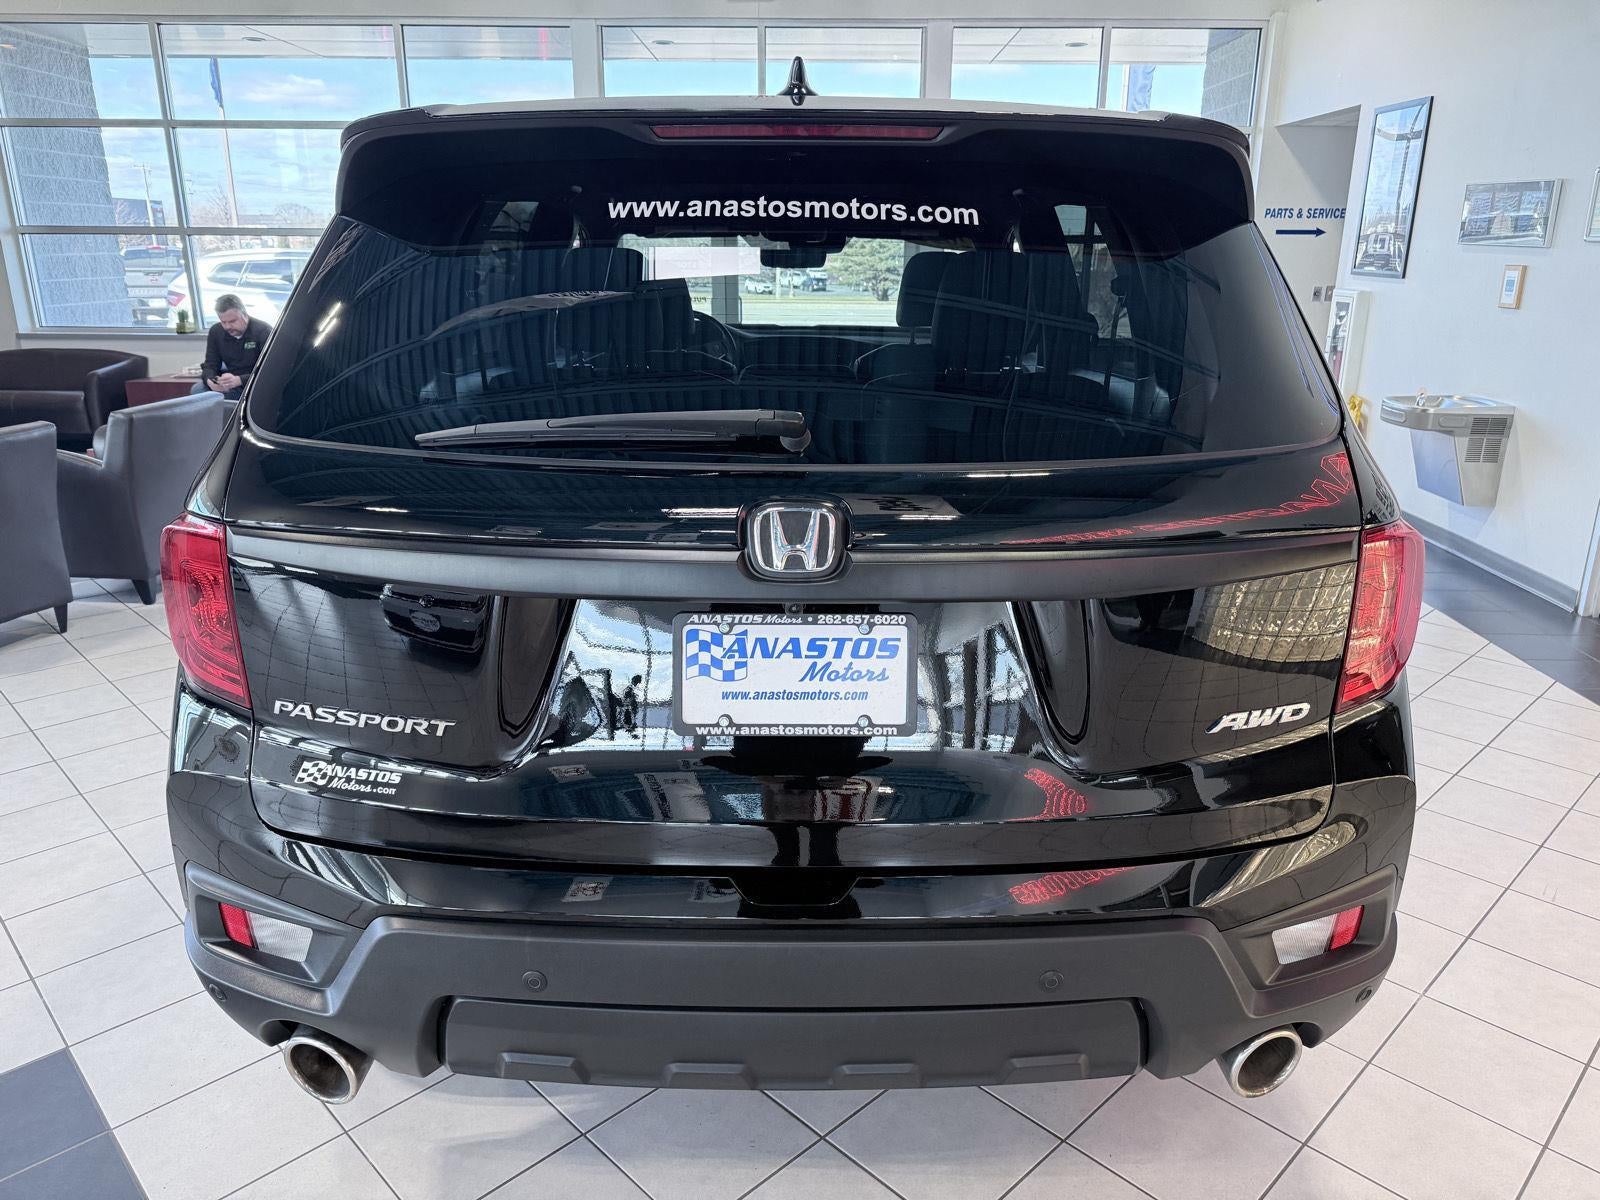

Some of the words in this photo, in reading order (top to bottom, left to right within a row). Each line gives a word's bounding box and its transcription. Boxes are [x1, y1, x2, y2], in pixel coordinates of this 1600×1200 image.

[607, 195, 980, 226] www.anastosmotors.com
[1265, 208, 1294, 219] PARTS
[1297, 208, 1303, 219] &
[1306, 208, 1346, 219] SERVICE
[687, 614, 763, 625] ANASTOS
[763, 614, 803, 625] Motors
[817, 615, 907, 625] 262-657-6020
[721, 637, 901, 659] ANASTOS
[798, 661, 890, 683] Motors
[721, 688, 869, 701] www.anastosmotors.com
[273, 697, 457, 737] PASSPORT
[1205, 702, 1311, 734] AWD
[695, 724, 898, 736] www.anastosmotors.com
[319, 763, 403, 785] ANASTOS
